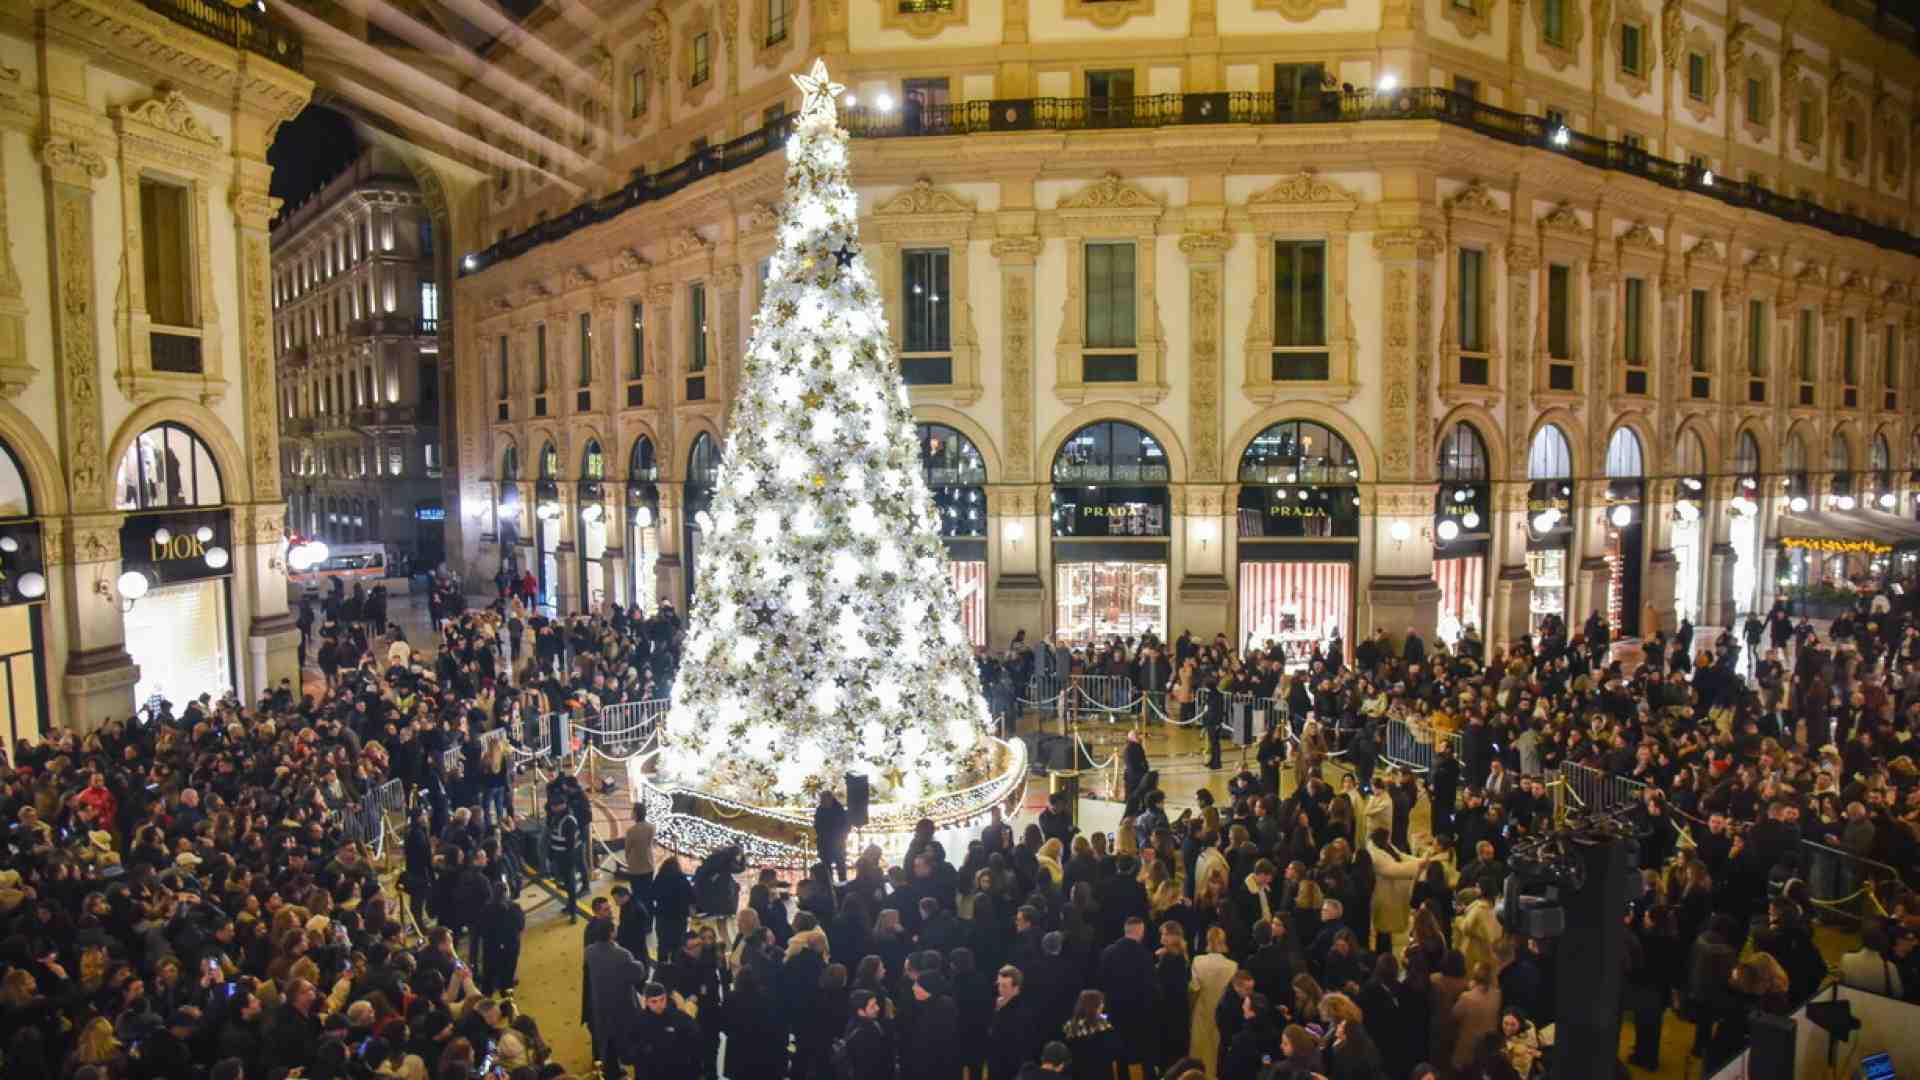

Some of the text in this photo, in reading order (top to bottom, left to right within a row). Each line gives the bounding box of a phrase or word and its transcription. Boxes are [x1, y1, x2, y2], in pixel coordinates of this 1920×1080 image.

[1083, 506, 1137, 517] PRADA
[1270, 506, 1327, 517] PRADA
[150, 534, 206, 562] DIOR
